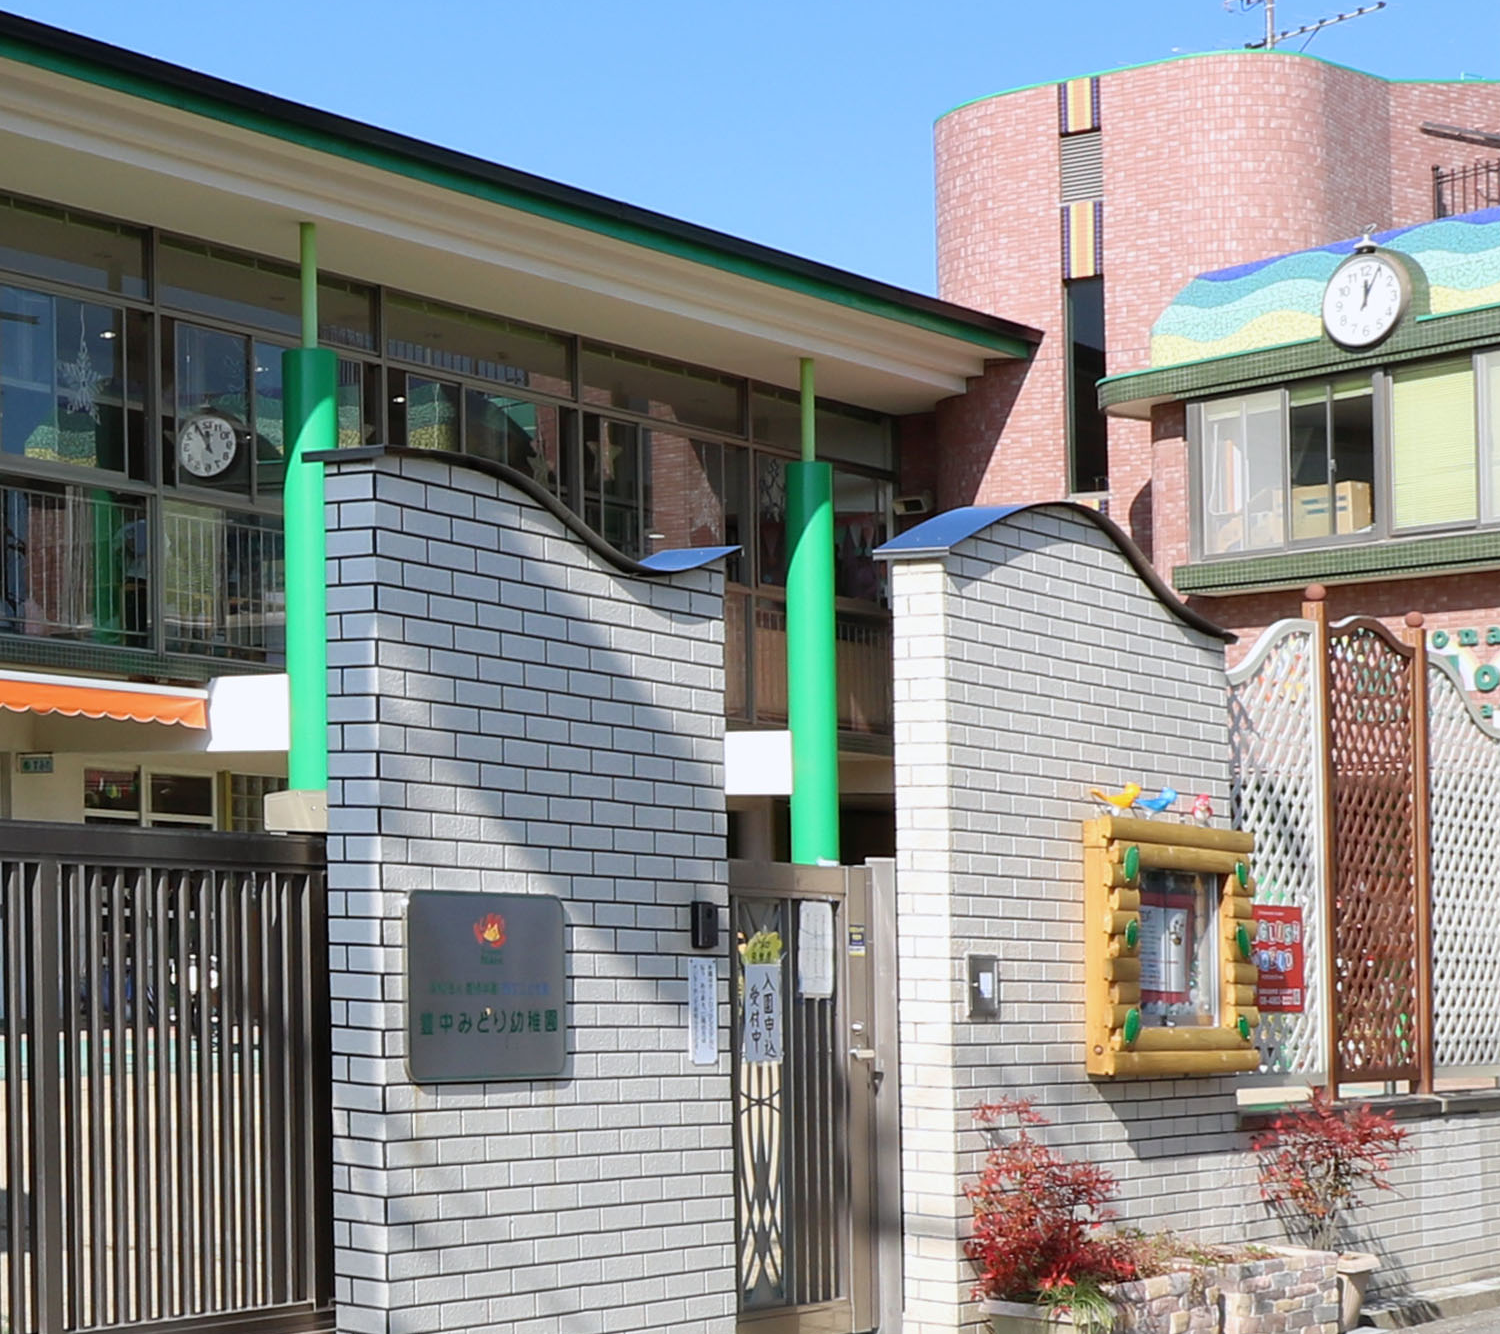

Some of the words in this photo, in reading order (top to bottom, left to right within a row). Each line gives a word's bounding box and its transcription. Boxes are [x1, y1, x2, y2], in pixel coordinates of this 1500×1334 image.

[1361, 265, 1371, 276] 12
[1348, 273, 1357, 283] 11
[1386, 275, 1393, 287] 2
[1339, 286, 1351, 297] 10
[1390, 290, 1397, 301] 3
[1336, 301, 1343, 312] 9
[1385, 306, 1392, 316] 4
[1340, 315, 1347, 326] 8
[1376, 318, 1383, 329] 5
[1351, 324, 1358, 334] 7
[1362, 325, 1370, 337] 6
[1251, 919, 1300, 946] GLISH
[749, 983, 762, 1054] 受付中
[762, 972, 777, 1058] 入園申込
[420, 1009, 558, 1035] 豊中みどり幼稚園
